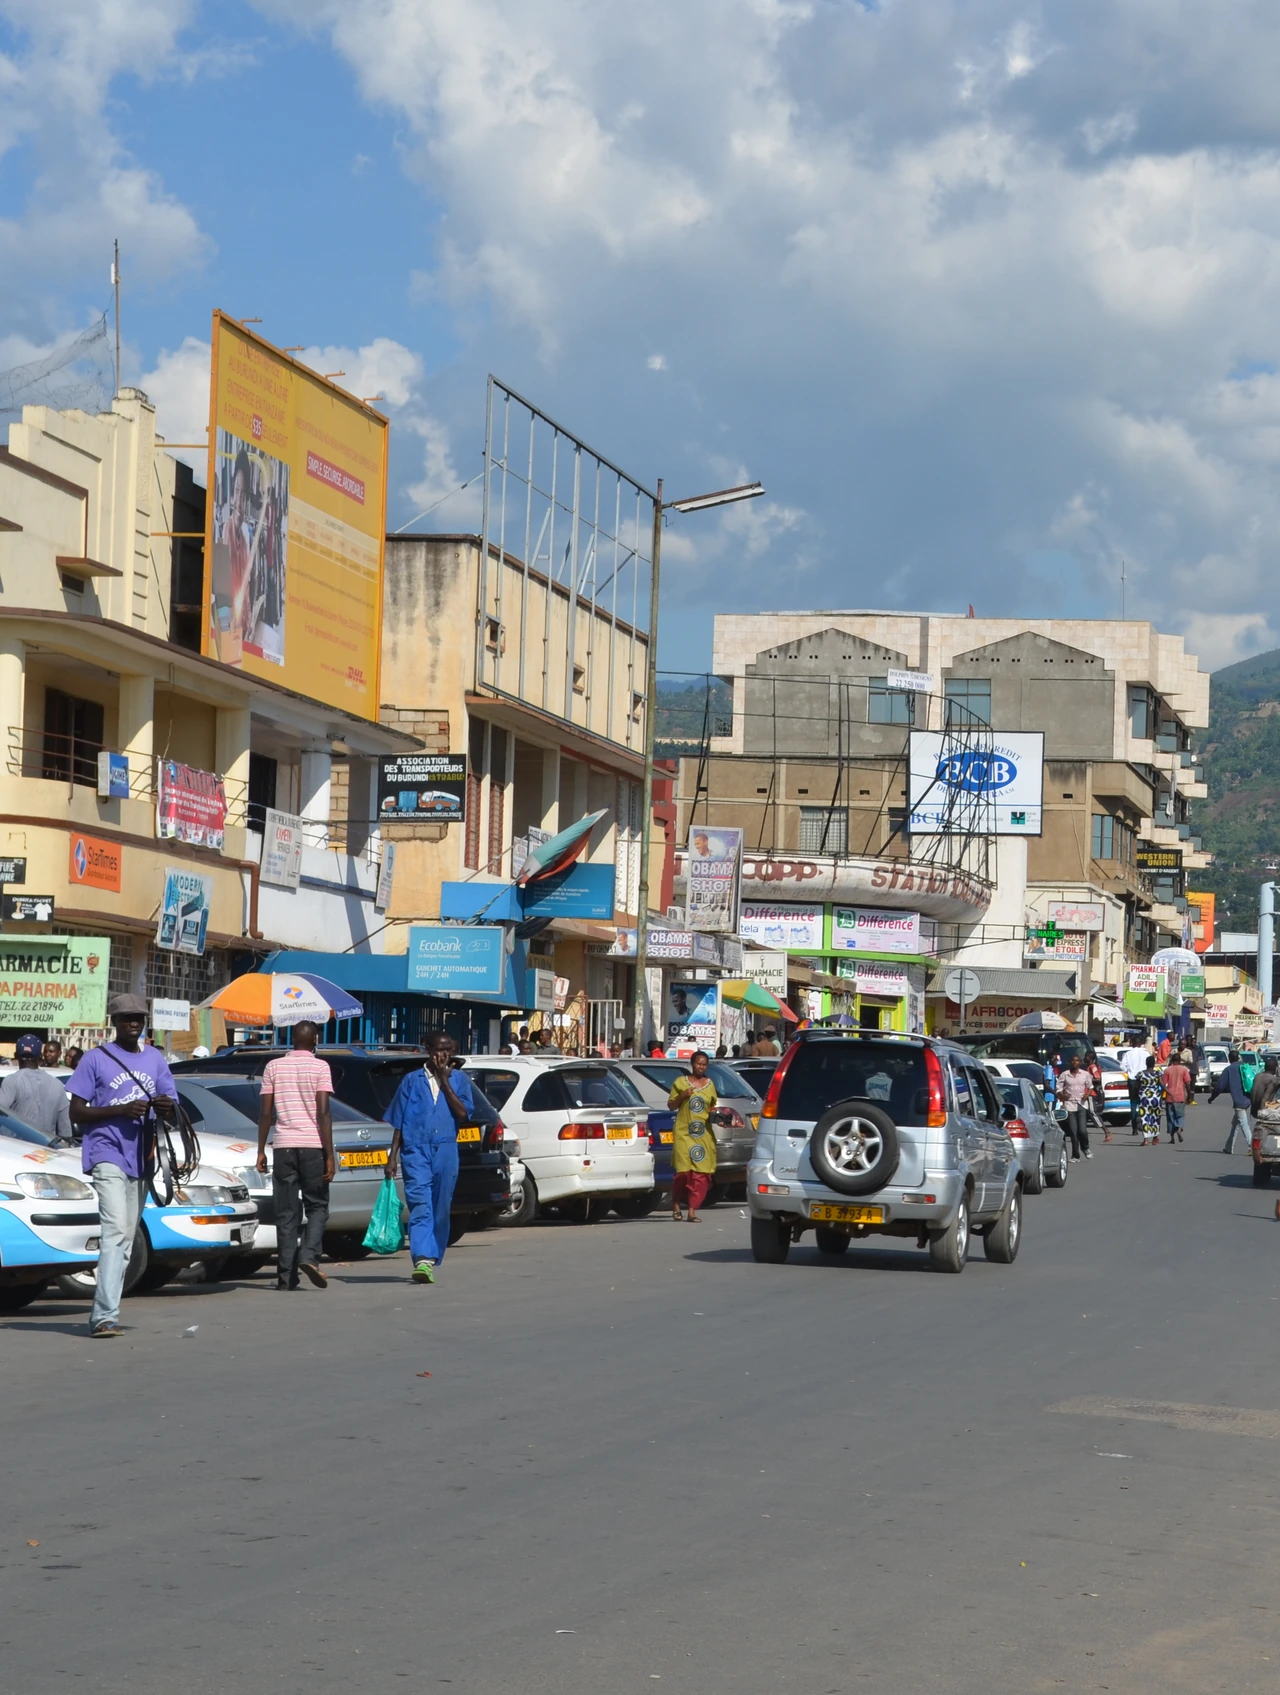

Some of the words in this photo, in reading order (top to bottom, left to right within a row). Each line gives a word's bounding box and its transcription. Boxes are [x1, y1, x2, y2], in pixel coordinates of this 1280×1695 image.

[402, 765, 463, 773] TRANSPORTEURS
[940, 761, 1010, 783] BCB
[692, 862, 734, 875] OBAMA
[871, 865, 950, 894] STATION
[691, 880, 731, 892] SHOP
[744, 907, 815, 922] Différence
[857, 915, 914, 931] Différence
[420, 936, 462, 952] Ecobank
[650, 932, 689, 944] OBAMA
[650, 947, 690, 957] SHOP
[746, 969, 783, 977] PHARMACIE
[857, 964, 904, 980] Différence
[1131, 965, 1167, 973] PHARMACIE
[32, 1002, 64, 1011] 218946
[279, 1001, 317, 1009] StarTimes
[13, 1014, 31, 1022] 1102
[34, 1014, 54, 1022] BUJA
[670, 1025, 713, 1035] OBAMA
[109, 1071, 156, 1094] BURLNGTON
[470, 1131, 475, 1139] A
[378, 1153, 382, 1163] A
[826, 1208, 831, 1219] B
[866, 1210, 872, 1220] A
